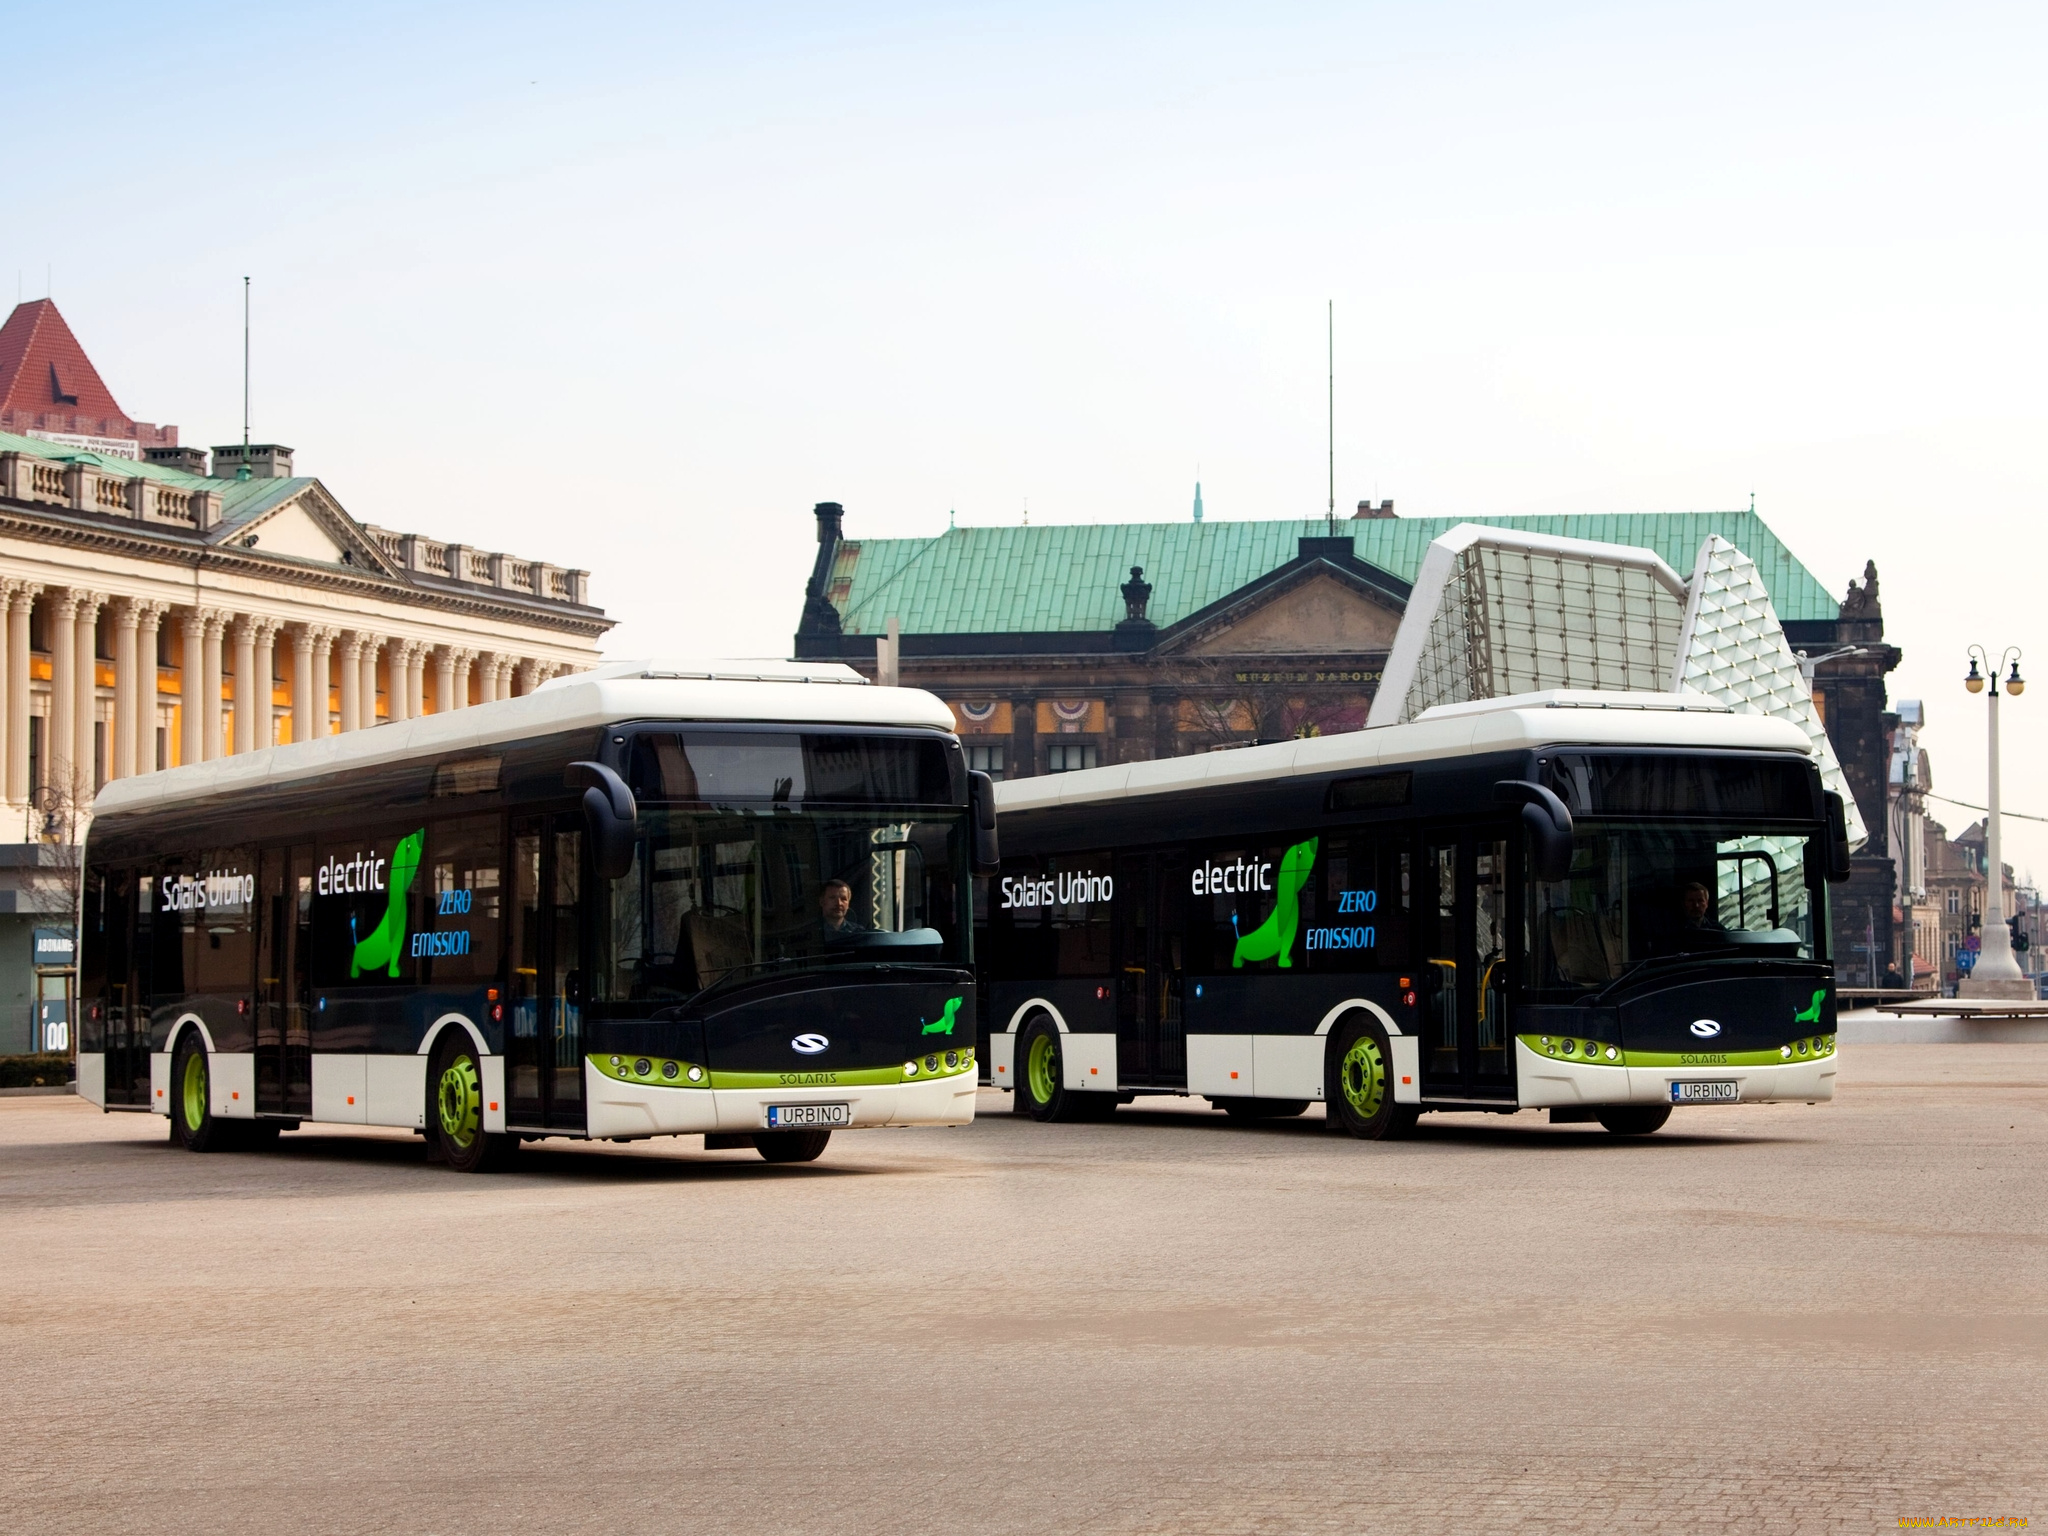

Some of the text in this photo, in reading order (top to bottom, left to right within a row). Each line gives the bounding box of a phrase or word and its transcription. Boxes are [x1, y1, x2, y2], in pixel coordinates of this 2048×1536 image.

[1235, 672, 1382, 682] MUZEUM NARODO
[318, 851, 385, 896] electric
[1191, 856, 1272, 896] electric
[162, 868, 254, 912] Solaris Urbino
[1001, 870, 1113, 909] Solaris Urbino
[438, 889, 472, 915] ZERO
[1338, 890, 1377, 914] ZERO
[411, 930, 470, 957] EMISSION
[1306, 926, 1375, 950] EMISSION
[1680, 1054, 1728, 1064] SOLARIS
[779, 1073, 837, 1085] SOLARIS
[1684, 1084, 1732, 1098] URBINO
[783, 1107, 842, 1123] URBINO
